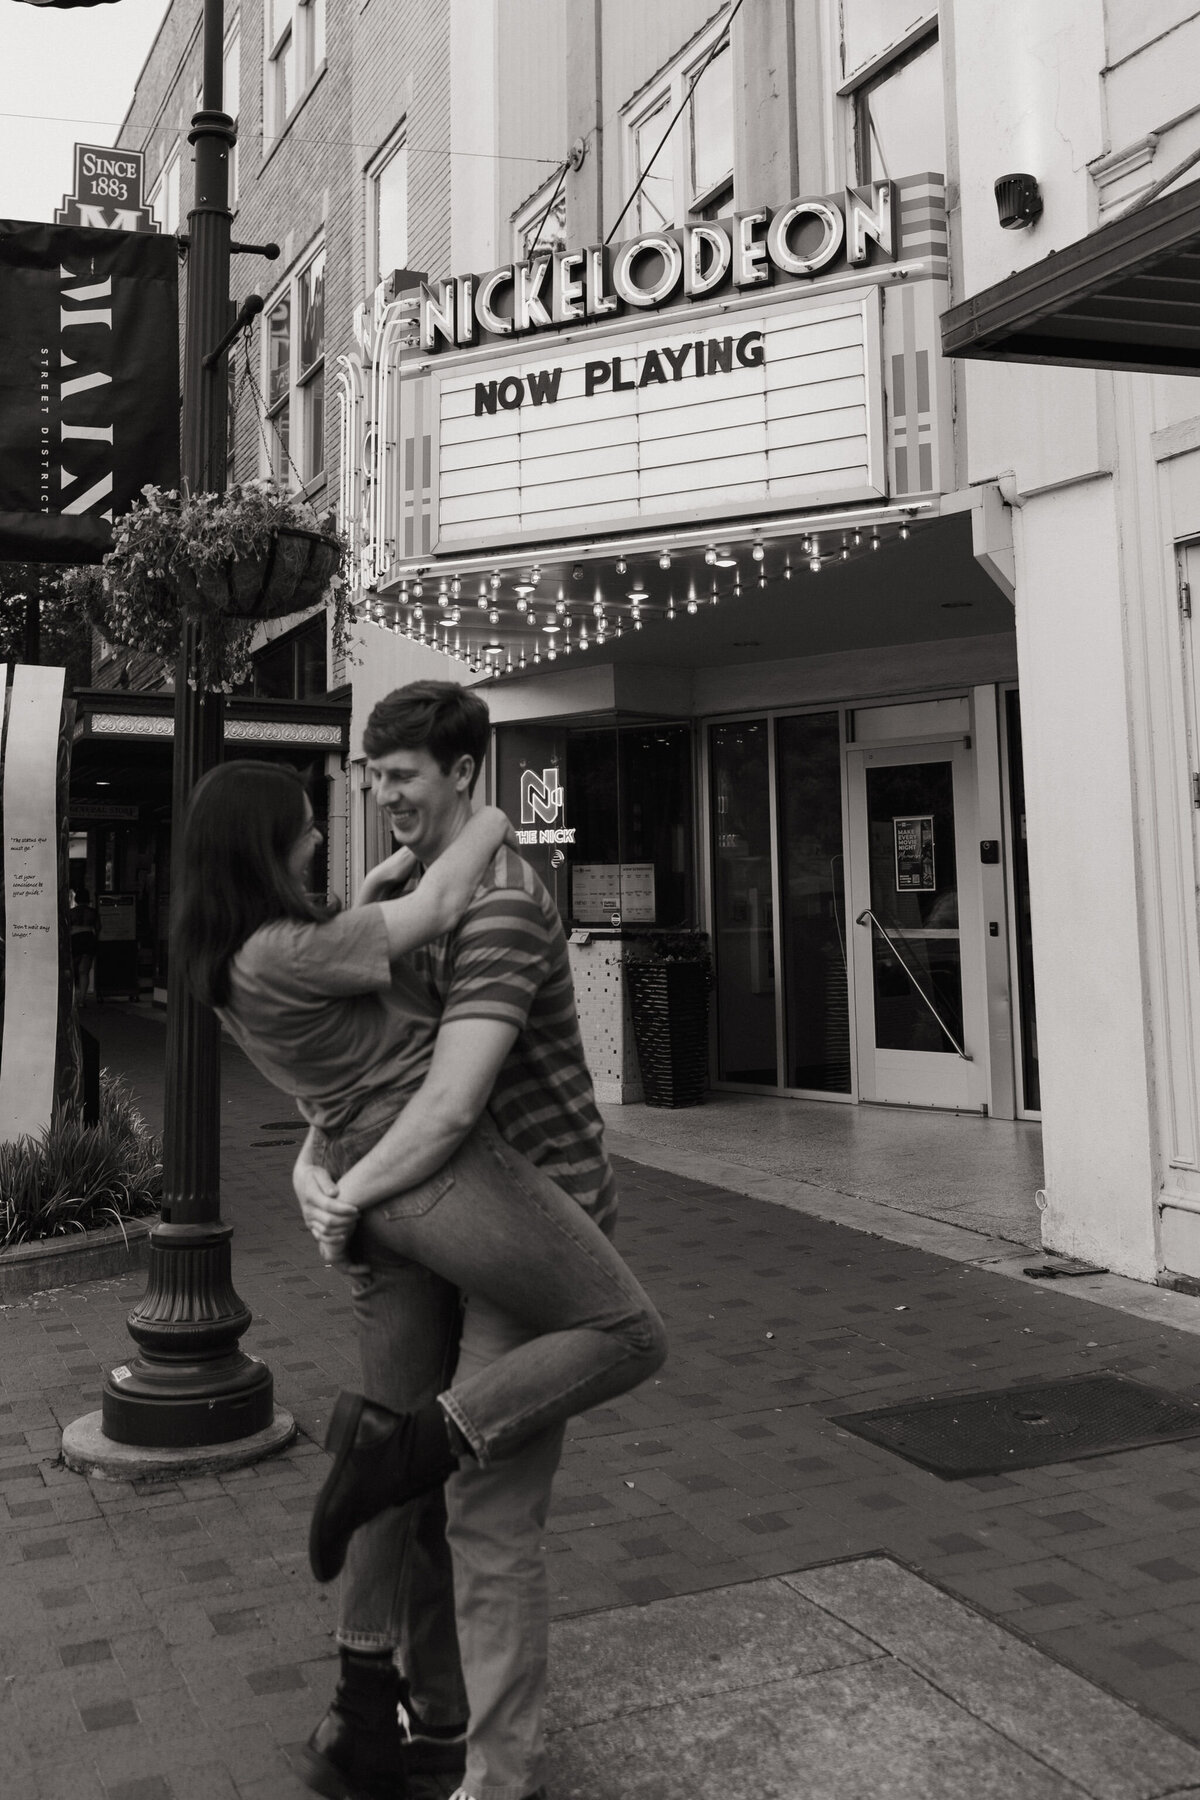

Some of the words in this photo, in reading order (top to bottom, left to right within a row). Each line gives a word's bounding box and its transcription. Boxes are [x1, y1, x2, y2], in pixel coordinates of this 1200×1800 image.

[90, 177, 128, 201] 1883
[420, 179, 896, 353] NICKELODEON
[41, 348, 49, 413] STREET
[60, 263, 113, 525] MAIN
[474, 367, 562, 417] NOW
[585, 331, 764, 397] PLAYING
[41, 427, 49, 513] DISTRICT
[539, 828, 576, 844] NICK
[12, 890, 25, 898] your
[39, 925, 50, 933] any
